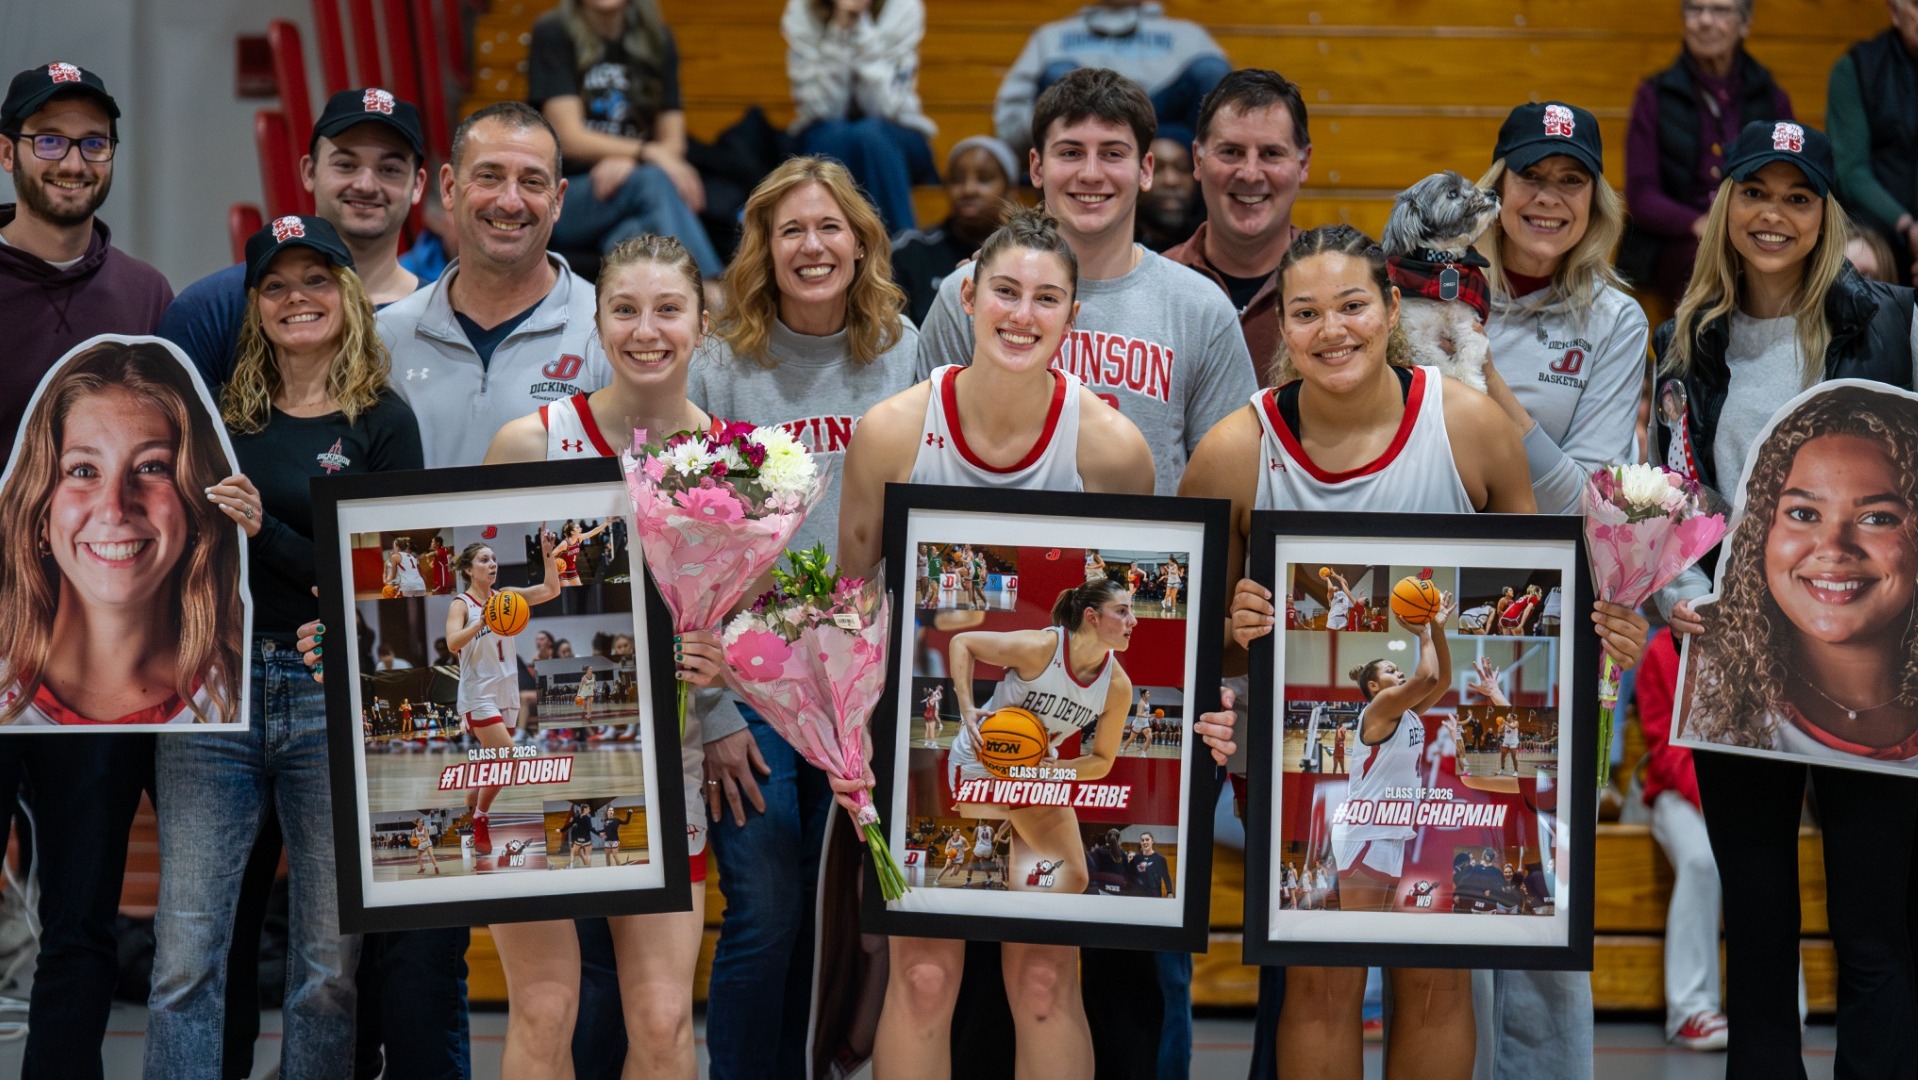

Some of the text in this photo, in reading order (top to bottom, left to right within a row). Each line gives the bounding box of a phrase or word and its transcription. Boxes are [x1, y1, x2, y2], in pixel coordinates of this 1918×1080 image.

[1548, 338, 1593, 352] DICKINSON
[1047, 329, 1174, 403] KINSON
[529, 381, 583, 396] DICKINSO
[1021, 691, 1056, 715] RED
[468, 745, 537, 761] CLASS OF 2026
[440, 757, 572, 789] #1 LEAH DUBIN
[1009, 766, 1077, 780] CLASS OF 2026
[956, 779, 1131, 808] #11 VICTORIA ZERBE
[1385, 787, 1454, 800] CLASS OF 2026
[1332, 801, 1508, 827] #40 MIA CHAPMAN
[509, 854, 526, 867] WB
[1039, 874, 1055, 887] WB
[1416, 895, 1432, 907] WB
